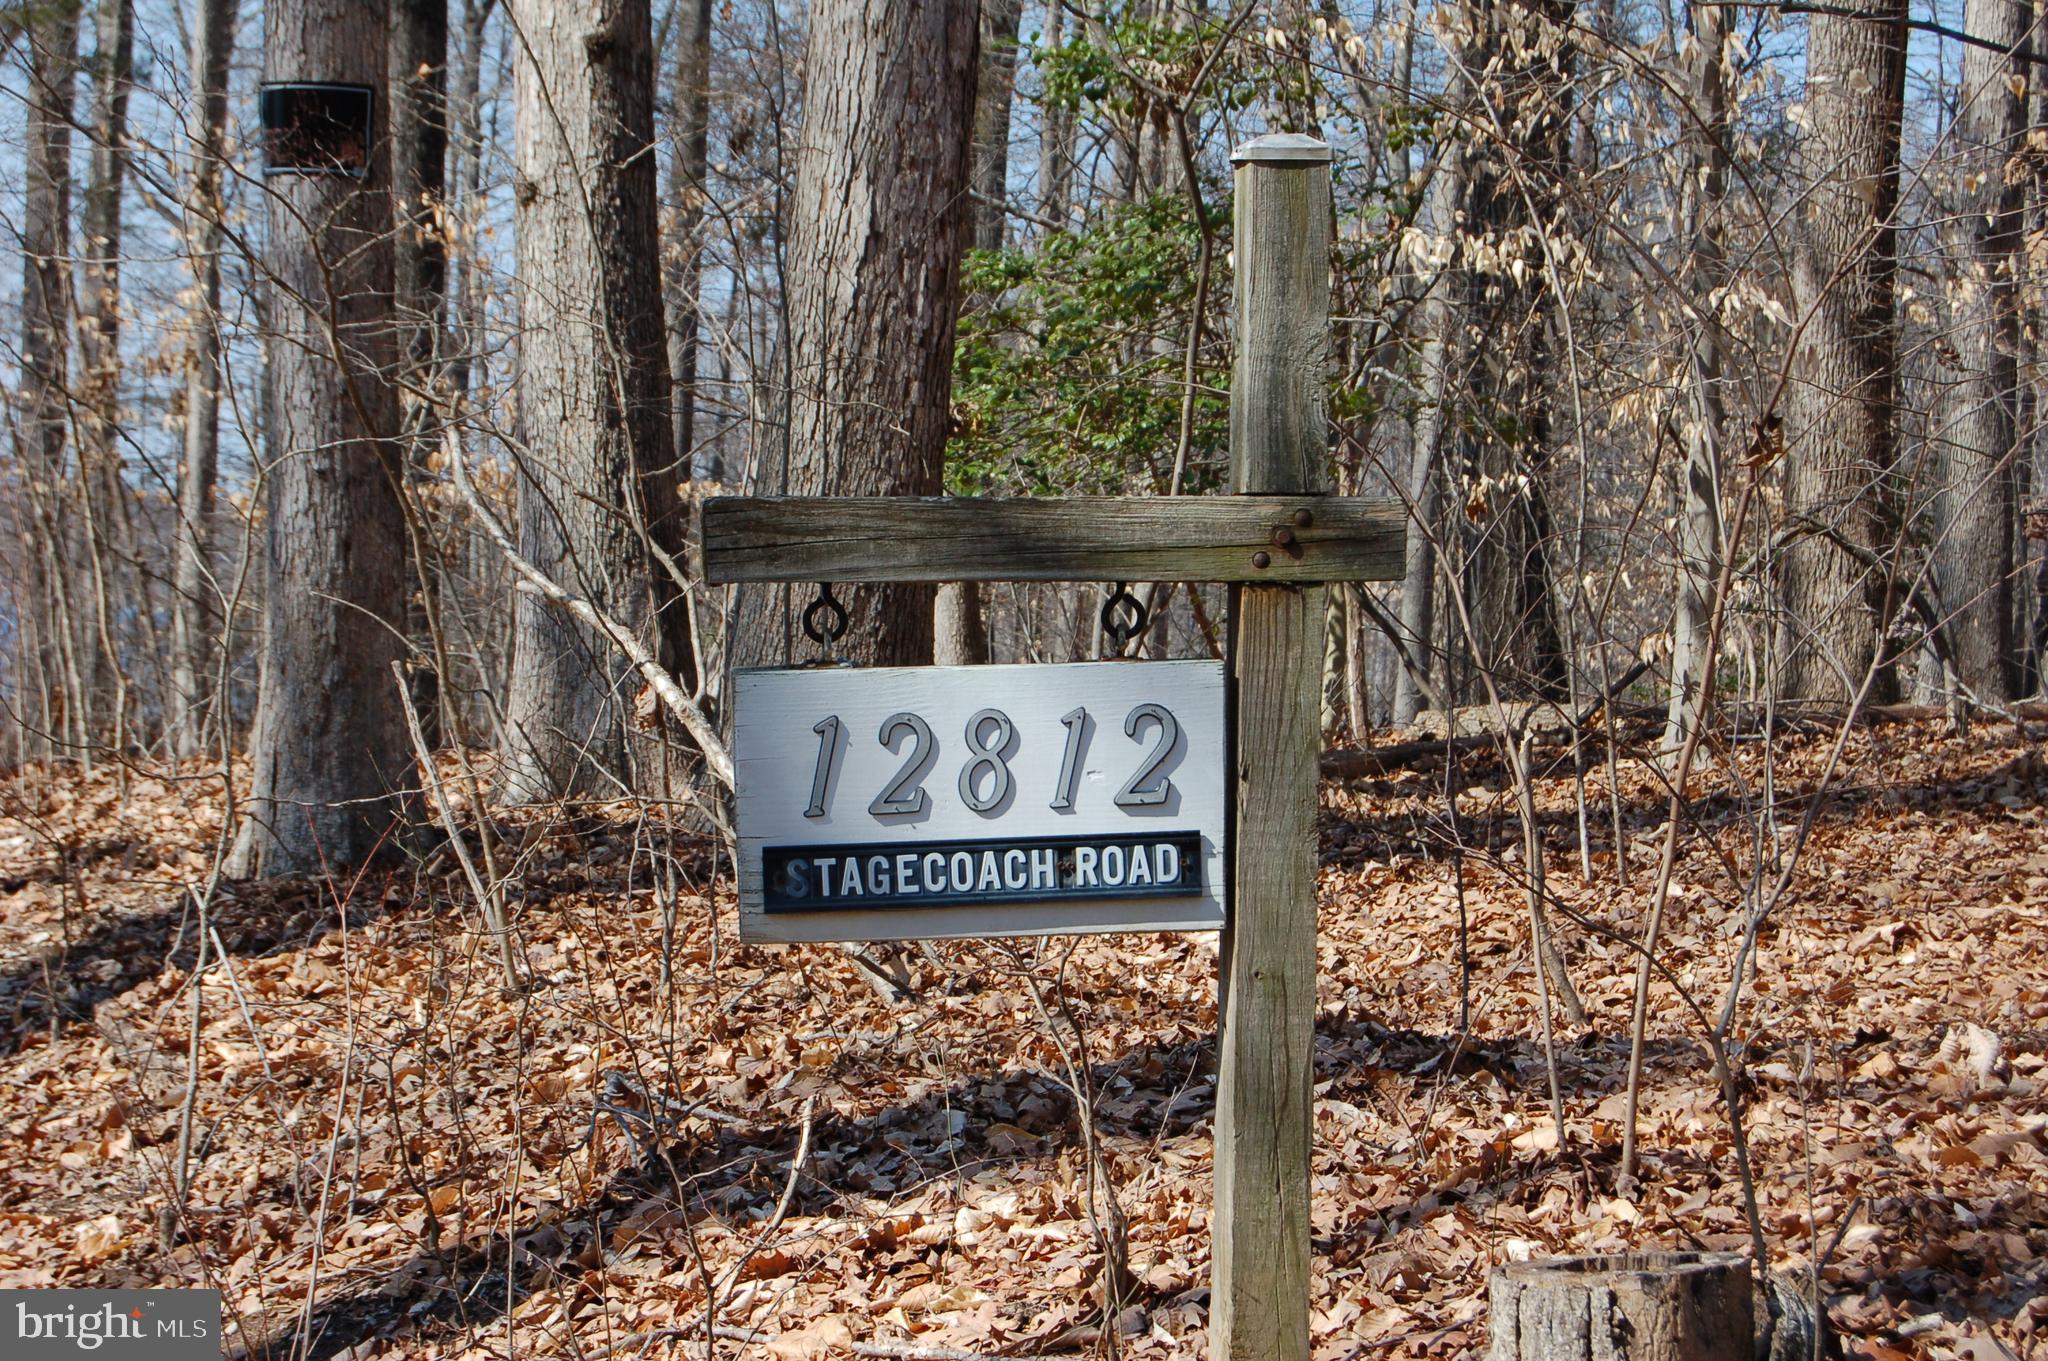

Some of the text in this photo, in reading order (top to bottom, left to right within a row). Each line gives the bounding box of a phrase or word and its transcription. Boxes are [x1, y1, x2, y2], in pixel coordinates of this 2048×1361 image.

[803, 703, 1178, 818] 12812
[786, 843, 1180, 898] STAGECOACH ROAD
